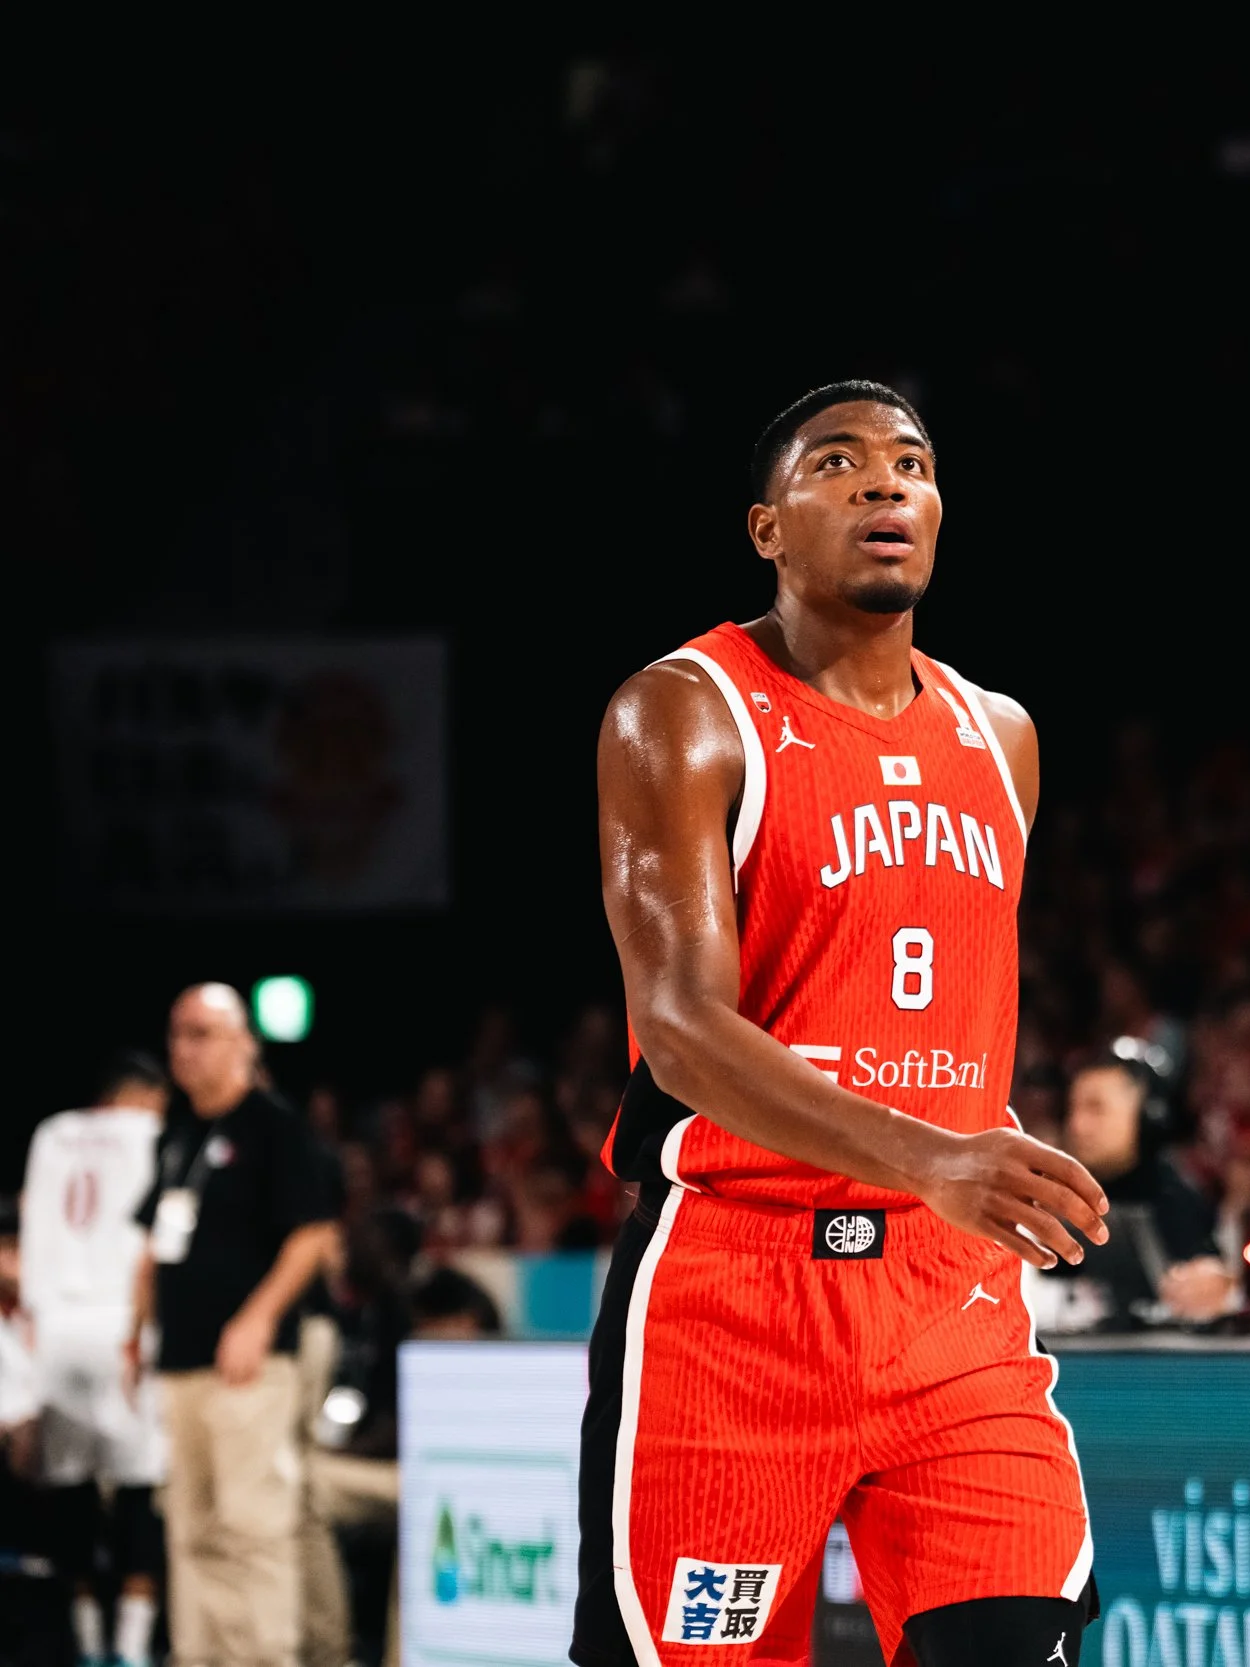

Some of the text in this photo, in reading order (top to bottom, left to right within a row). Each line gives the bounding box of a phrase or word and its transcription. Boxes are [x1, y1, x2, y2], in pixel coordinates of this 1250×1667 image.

[820, 800, 1004, 890] JAPAN
[892, 927, 934, 1011] 8
[852, 1047, 987, 1089] SoftBn
[845, 1215, 855, 1253] JPN
[681, 1566, 727, 1640] 大吉
[720, 1568, 769, 1639] 買取
